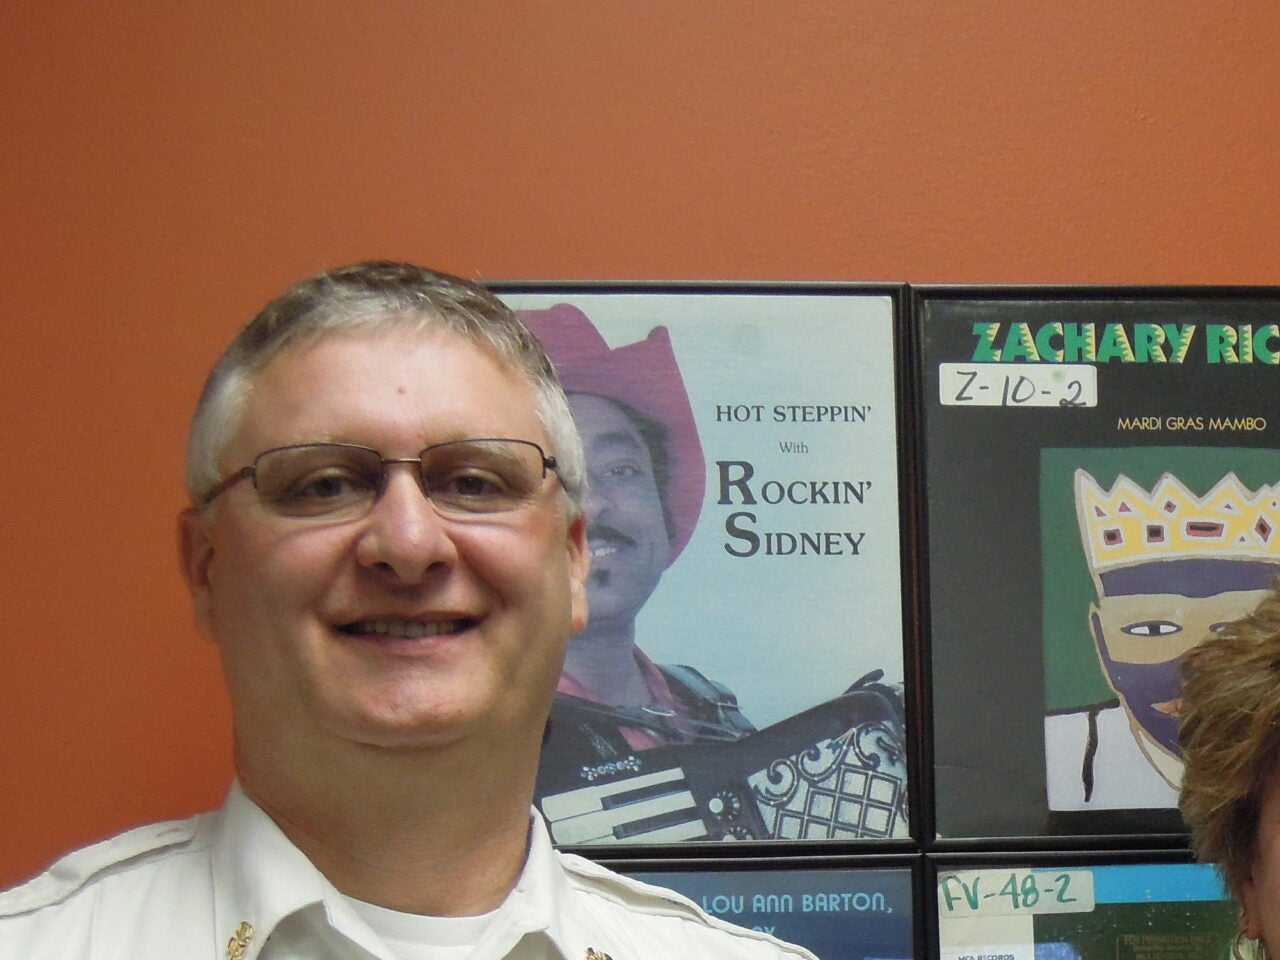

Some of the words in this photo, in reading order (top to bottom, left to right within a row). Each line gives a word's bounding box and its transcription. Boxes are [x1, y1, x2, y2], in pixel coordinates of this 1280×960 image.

[971, 322, 1196, 363] ZACHARY
[954, 370, 1087, 407] Z-10-2
[716, 405, 765, 422] HOT
[773, 405, 872, 422] STEPPIN'
[1117, 417, 1162, 431] MARDI
[1166, 418, 1204, 431] GRAS
[1208, 418, 1267, 432] MAMBO
[779, 441, 809, 454] With
[724, 511, 866, 558] SIDNEY
[702, 895, 744, 914] LOU
[752, 894, 793, 913] ANN
[802, 892, 893, 914] BARTON,
[939, 873, 1077, 911] FV-48-2
